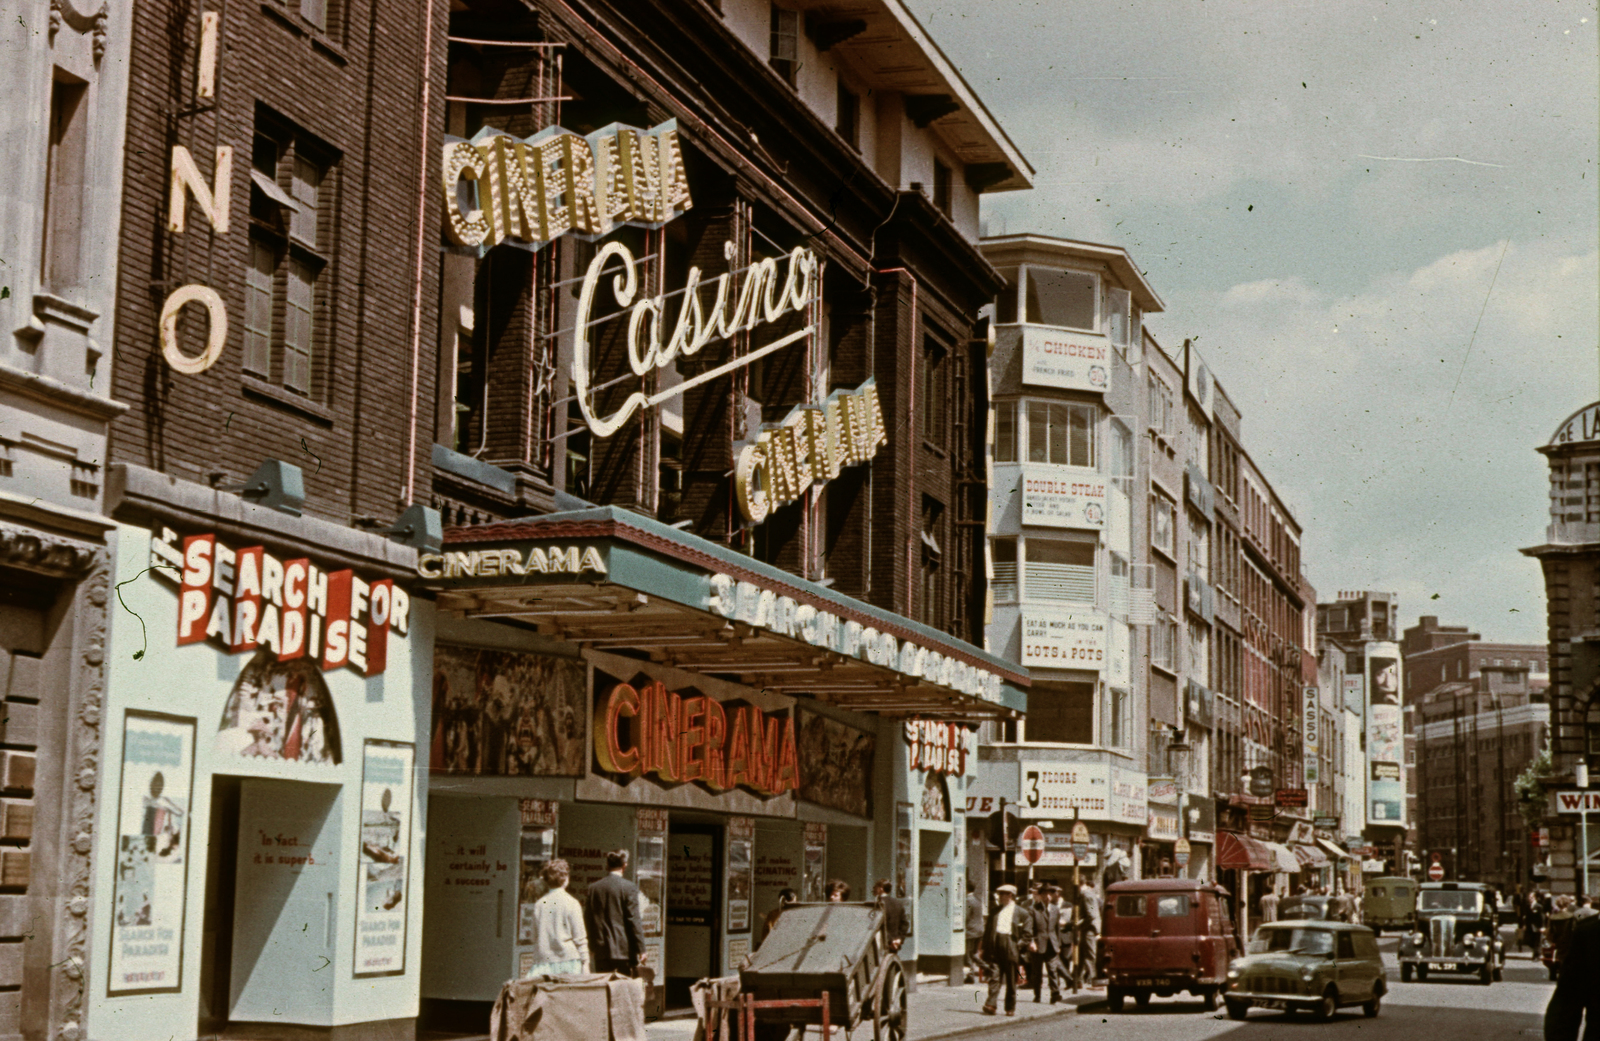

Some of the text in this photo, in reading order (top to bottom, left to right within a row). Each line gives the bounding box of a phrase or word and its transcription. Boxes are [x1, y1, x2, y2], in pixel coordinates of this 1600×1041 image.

[442, 127, 693, 247] CINERAMA
[574, 240, 817, 437] Casino
[1044, 341, 1107, 360] CHICKEN
[736, 385, 888, 522] CINERAMA
[1026, 479, 1105, 498] DOUBLE STEAK
[416, 545, 608, 579] CINERAMA
[183, 538, 328, 617] SEARCH
[351, 575, 410, 634] FOR
[179, 589, 369, 673] PARADISE
[708, 572, 841, 651] SEARCH
[844, 620, 899, 673] FOR
[1026, 620, 1038, 628] EAT
[1039, 620, 1047, 628] AS
[1049, 621, 1066, 629] MUCH
[1078, 623, 1089, 631] YOU
[1026, 629, 1047, 637] CARRY
[1026, 645, 1059, 658] LOTS
[1071, 647, 1103, 661] POTS
[1305, 687, 1317, 742] SASSO
[594, 680, 800, 795] CINERAMA
[1027, 771, 1040, 808] 3
[1042, 771, 1077, 784] FLOORS
[1042, 797, 1105, 810] SPECIALITIES
[279, 852, 315, 867] superb
[469, 845, 486, 855] will
[449, 860, 507, 873] certainly be
[455, 878, 490, 886] success
